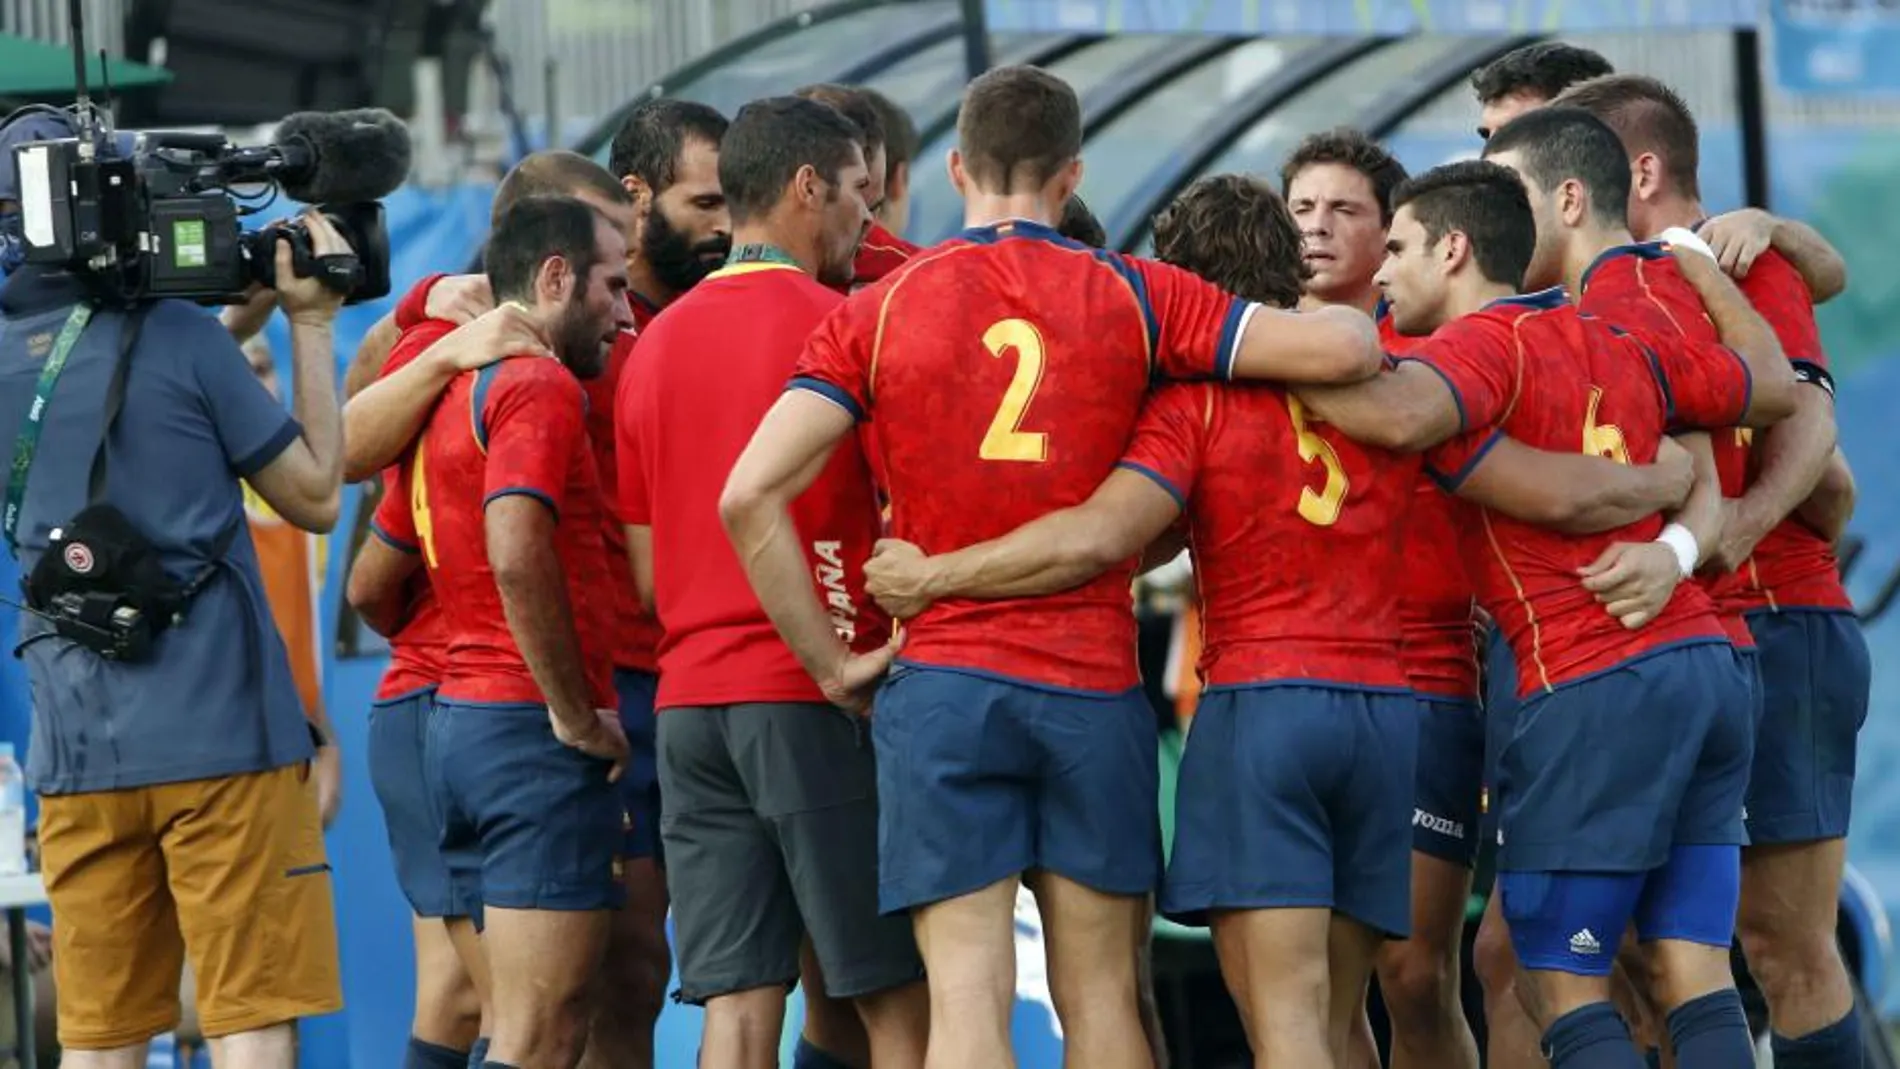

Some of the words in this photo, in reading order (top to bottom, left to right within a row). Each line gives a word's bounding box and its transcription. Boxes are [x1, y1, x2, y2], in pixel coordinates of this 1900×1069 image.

[979, 317, 1048, 462] 2
[411, 436, 439, 569] 4
[1288, 391, 1351, 525] 5
